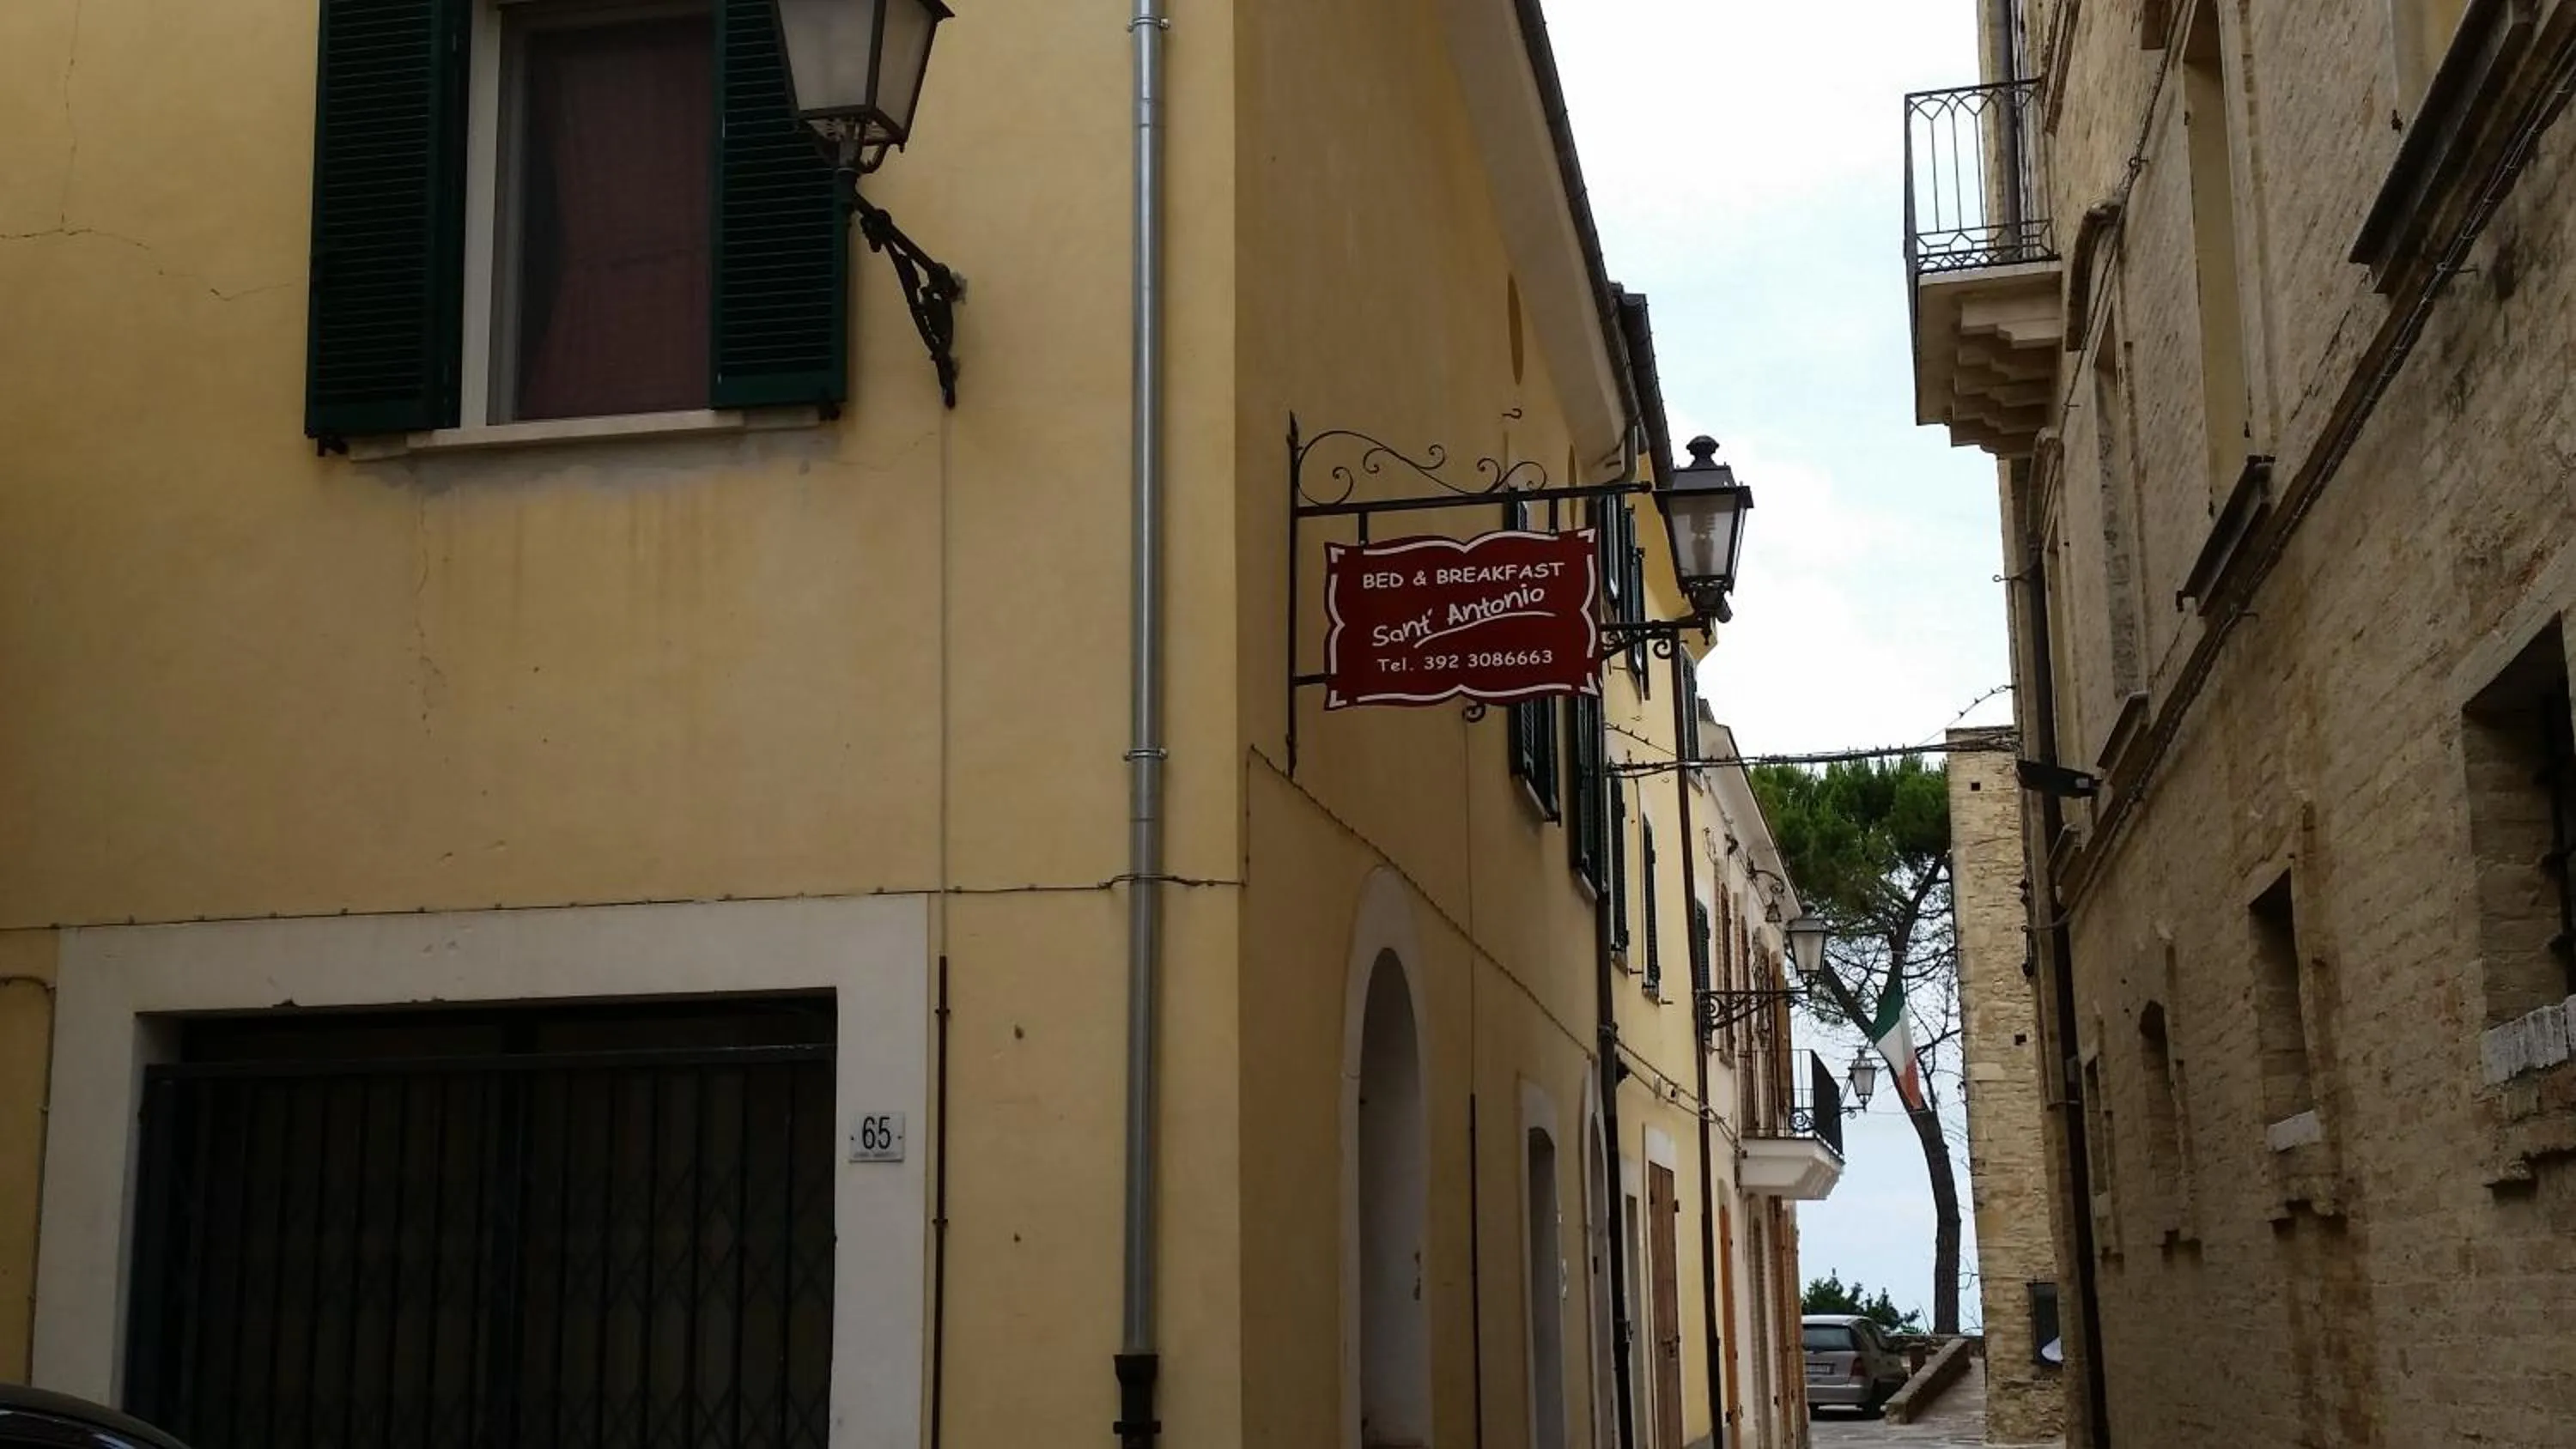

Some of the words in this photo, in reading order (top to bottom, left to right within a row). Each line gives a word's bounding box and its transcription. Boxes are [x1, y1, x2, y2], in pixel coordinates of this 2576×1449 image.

[1363, 573, 1404, 589] BED
[1413, 570, 1427, 586] &
[1436, 562, 1564, 585] BREAKFAST
[1372, 609, 1433, 646] Sant'
[1447, 583, 1545, 626] Antonio
[1377, 658, 1415, 672] Tel.
[1424, 654, 1459, 670] 392
[1467, 650, 1553, 668] 3086663
[862, 1116, 891, 1149] 65
